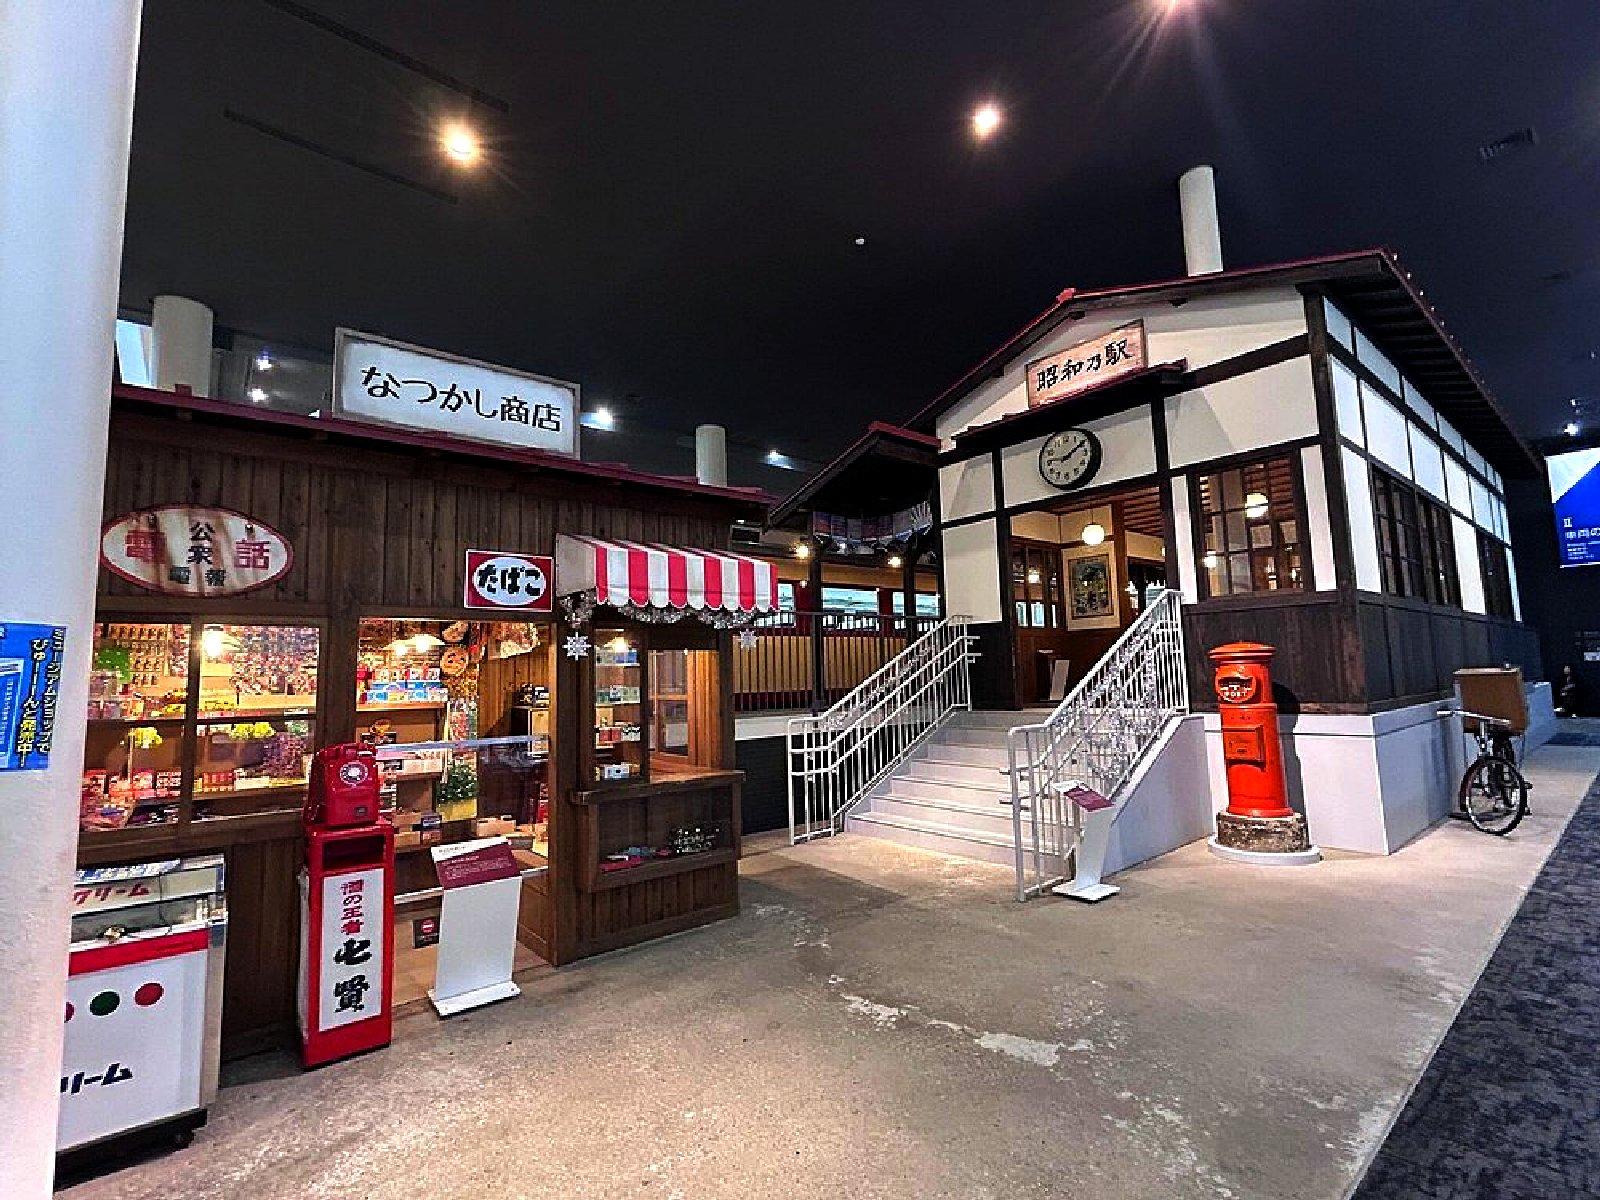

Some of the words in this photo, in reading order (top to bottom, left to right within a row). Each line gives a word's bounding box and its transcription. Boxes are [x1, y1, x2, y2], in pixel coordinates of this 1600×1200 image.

[361, 366, 561, 433] なつかし商店
[478, 564, 541, 597] たばこ
